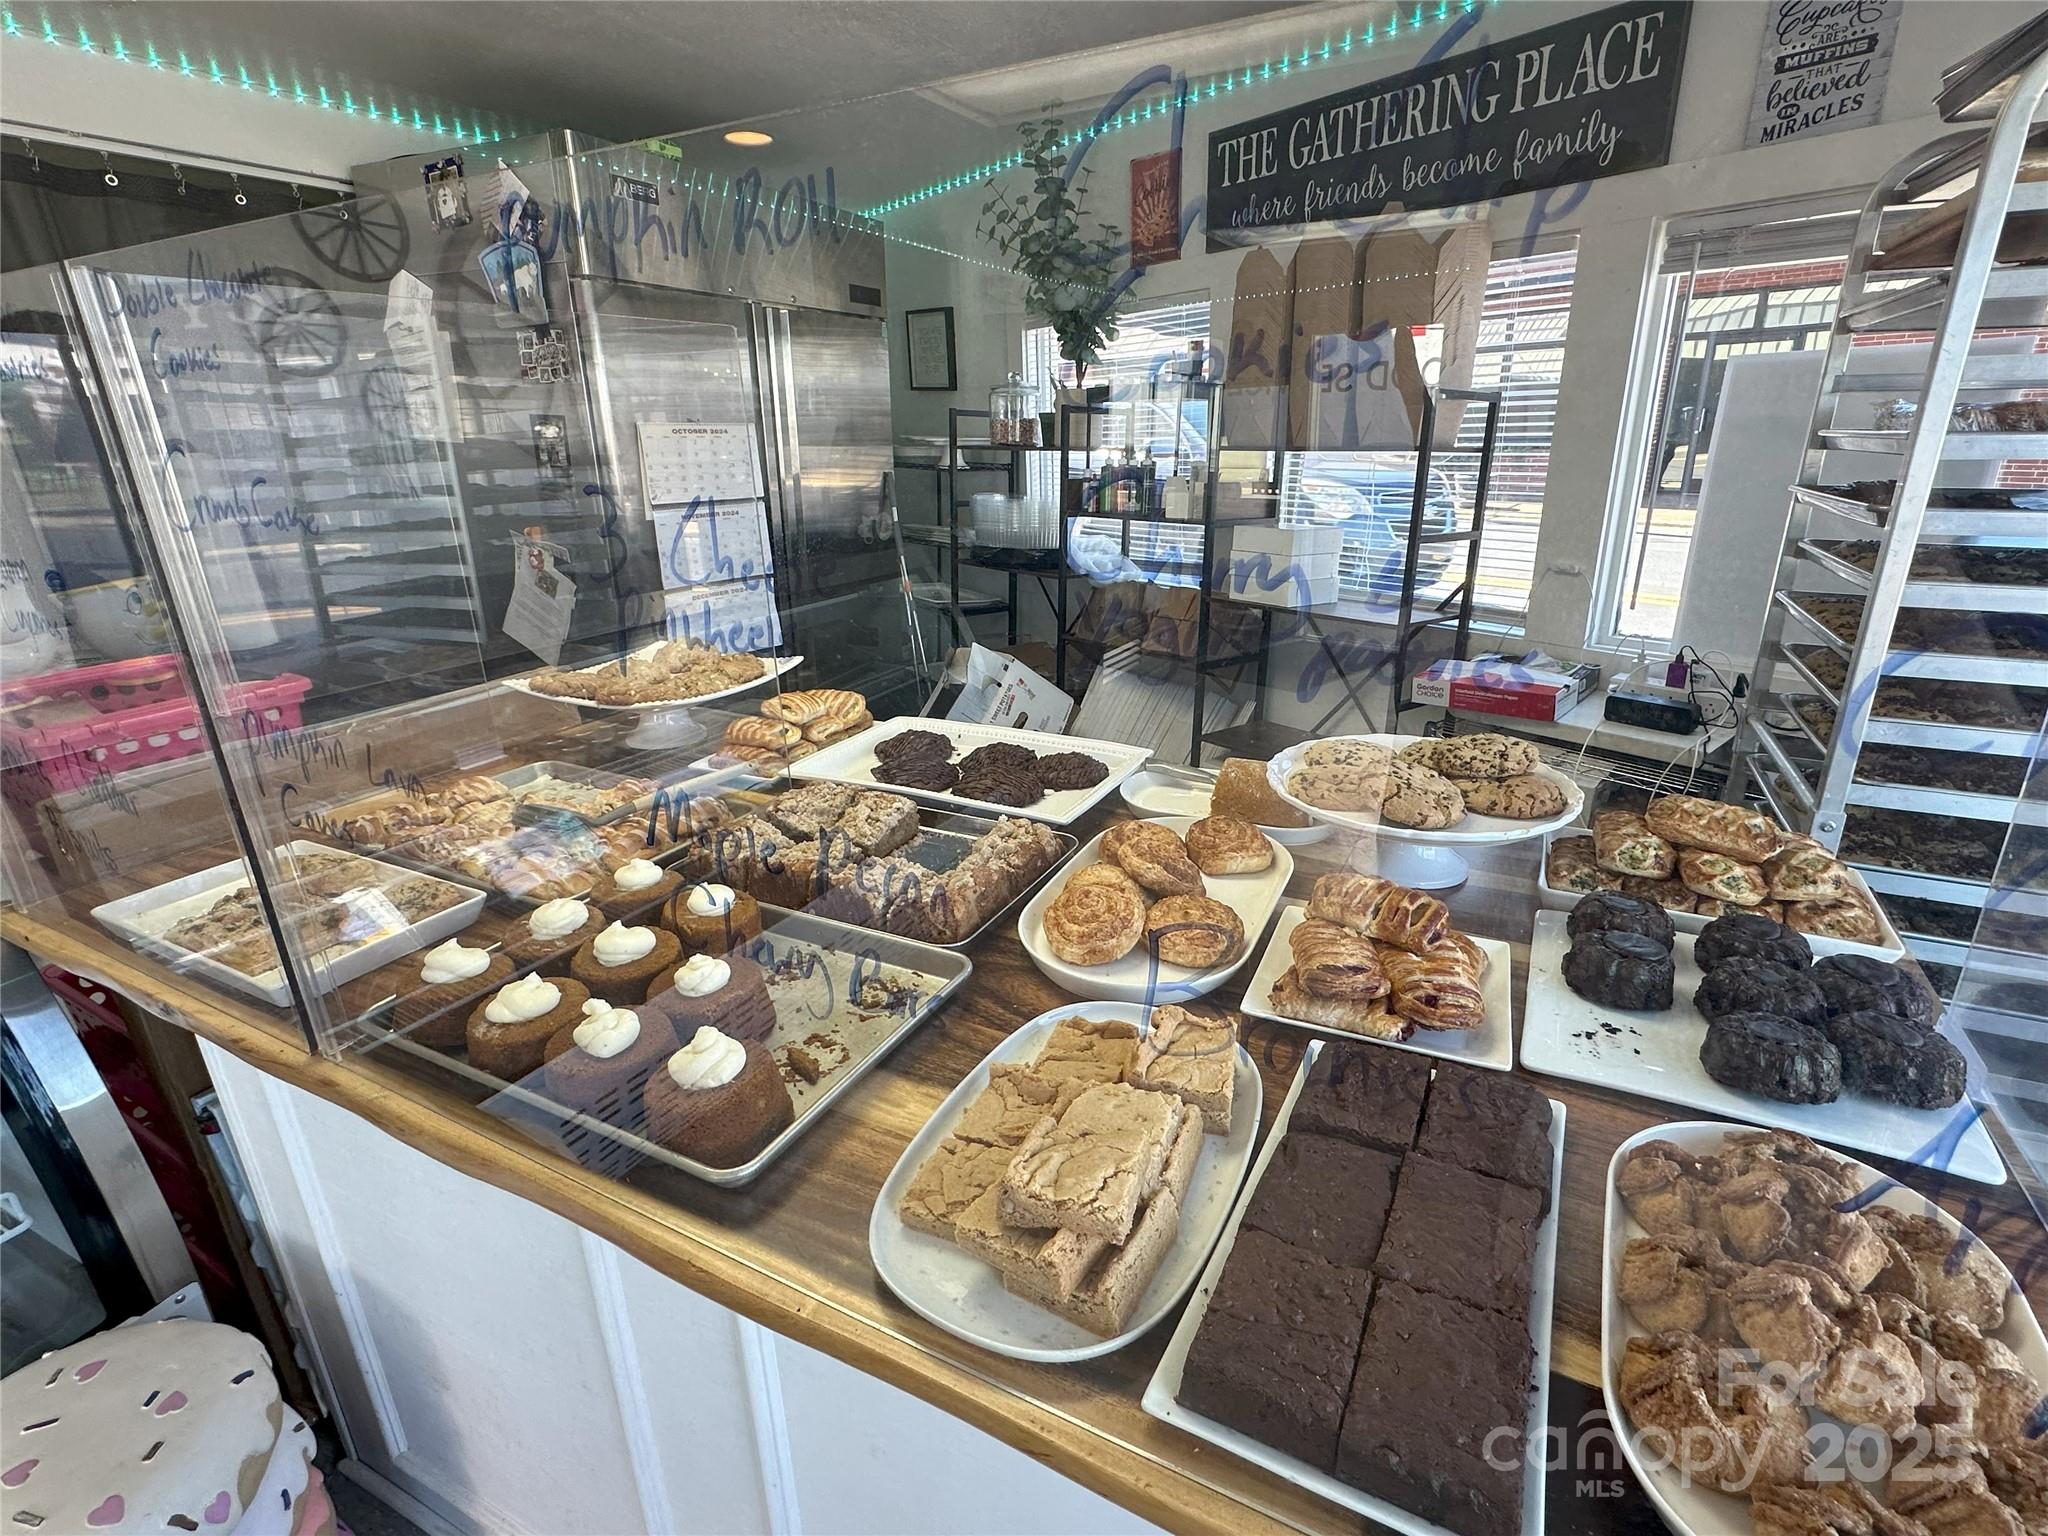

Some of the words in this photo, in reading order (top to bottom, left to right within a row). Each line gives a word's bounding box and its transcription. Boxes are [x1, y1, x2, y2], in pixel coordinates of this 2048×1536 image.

[1783, 39, 1869, 70] MUFFINS
[1817, 31, 1842, 46] ARE
[1766, 59, 1873, 111] believed
[1806, 62, 1844, 80] THAT
[1217, 126, 1278, 188] THE
[1288, 59, 1501, 171] GATHERING
[1513, 12, 1665, 114] PLACE
[1760, 93, 1866, 144] MIRACLES
[1231, 195, 1296, 229] where
[1303, 164, 1393, 223] friends
[1401, 148, 1504, 189] become
[1511, 109, 1624, 180] family
[1416, 683, 1445, 693] Gordon
[1416, 689, 1444, 699] CHOICE
[646, 787, 786, 884] Maple
